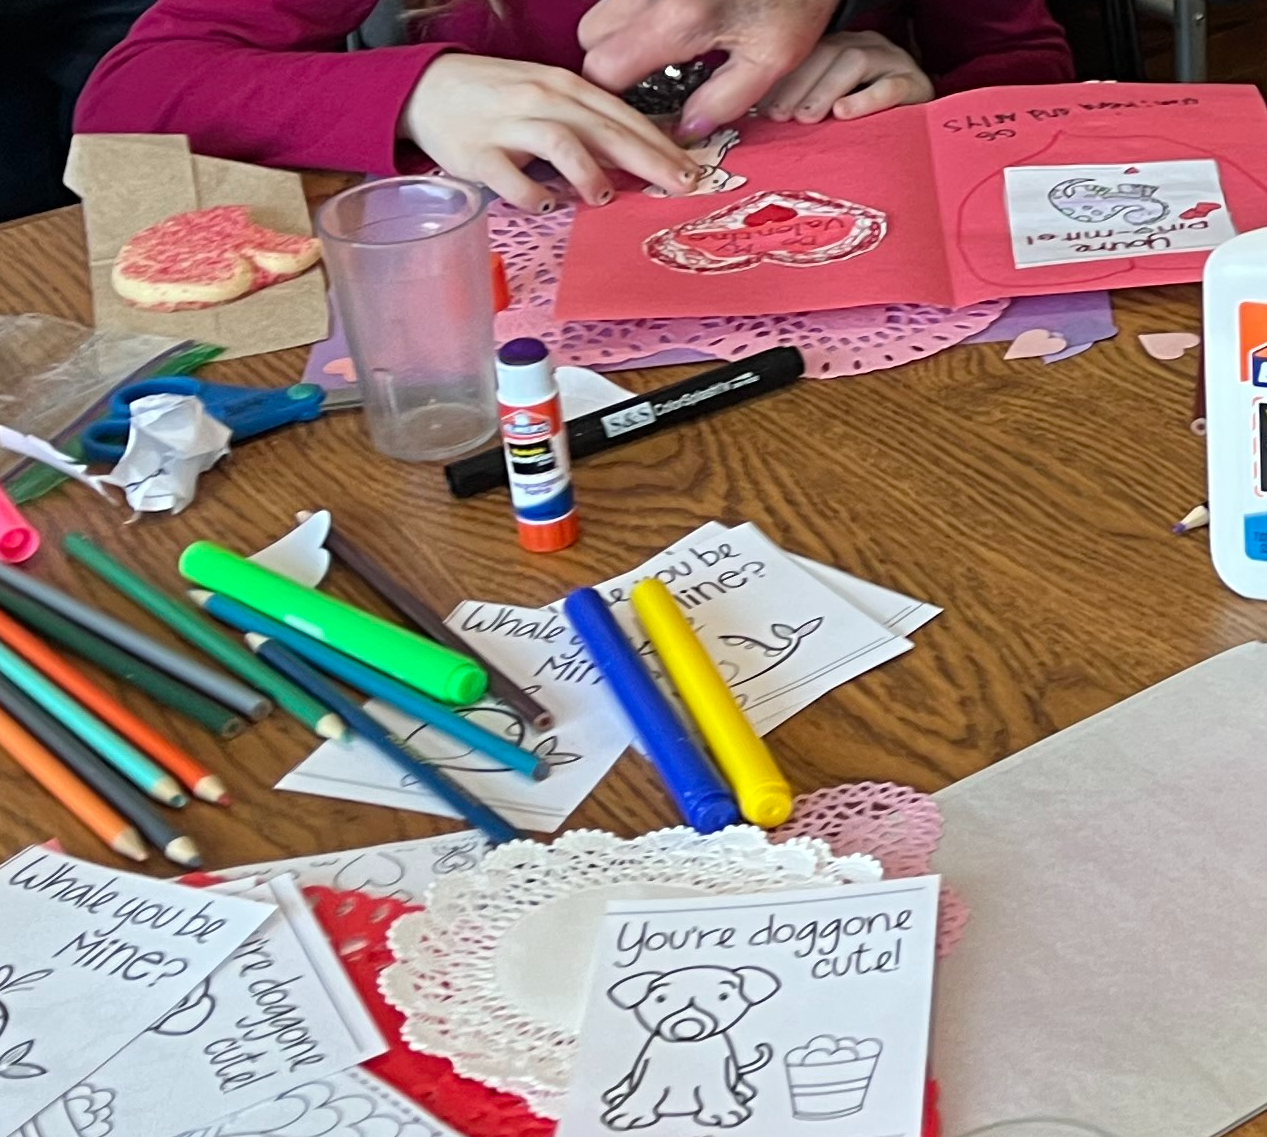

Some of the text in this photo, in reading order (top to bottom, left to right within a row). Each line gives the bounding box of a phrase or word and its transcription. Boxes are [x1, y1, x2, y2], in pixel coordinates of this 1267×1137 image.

[689, 543, 741, 567] be
[674, 561, 766, 610] ine?
[461, 605, 566, 643] Whale
[9, 855, 228, 944] Whale you be
[52, 930, 189, 988] Mine?
[613, 908, 913, 968] You're doggone
[810, 938, 901, 980] cute!
[234, 974, 326, 1073] doggone
[203, 1036, 279, 1096] cute!
